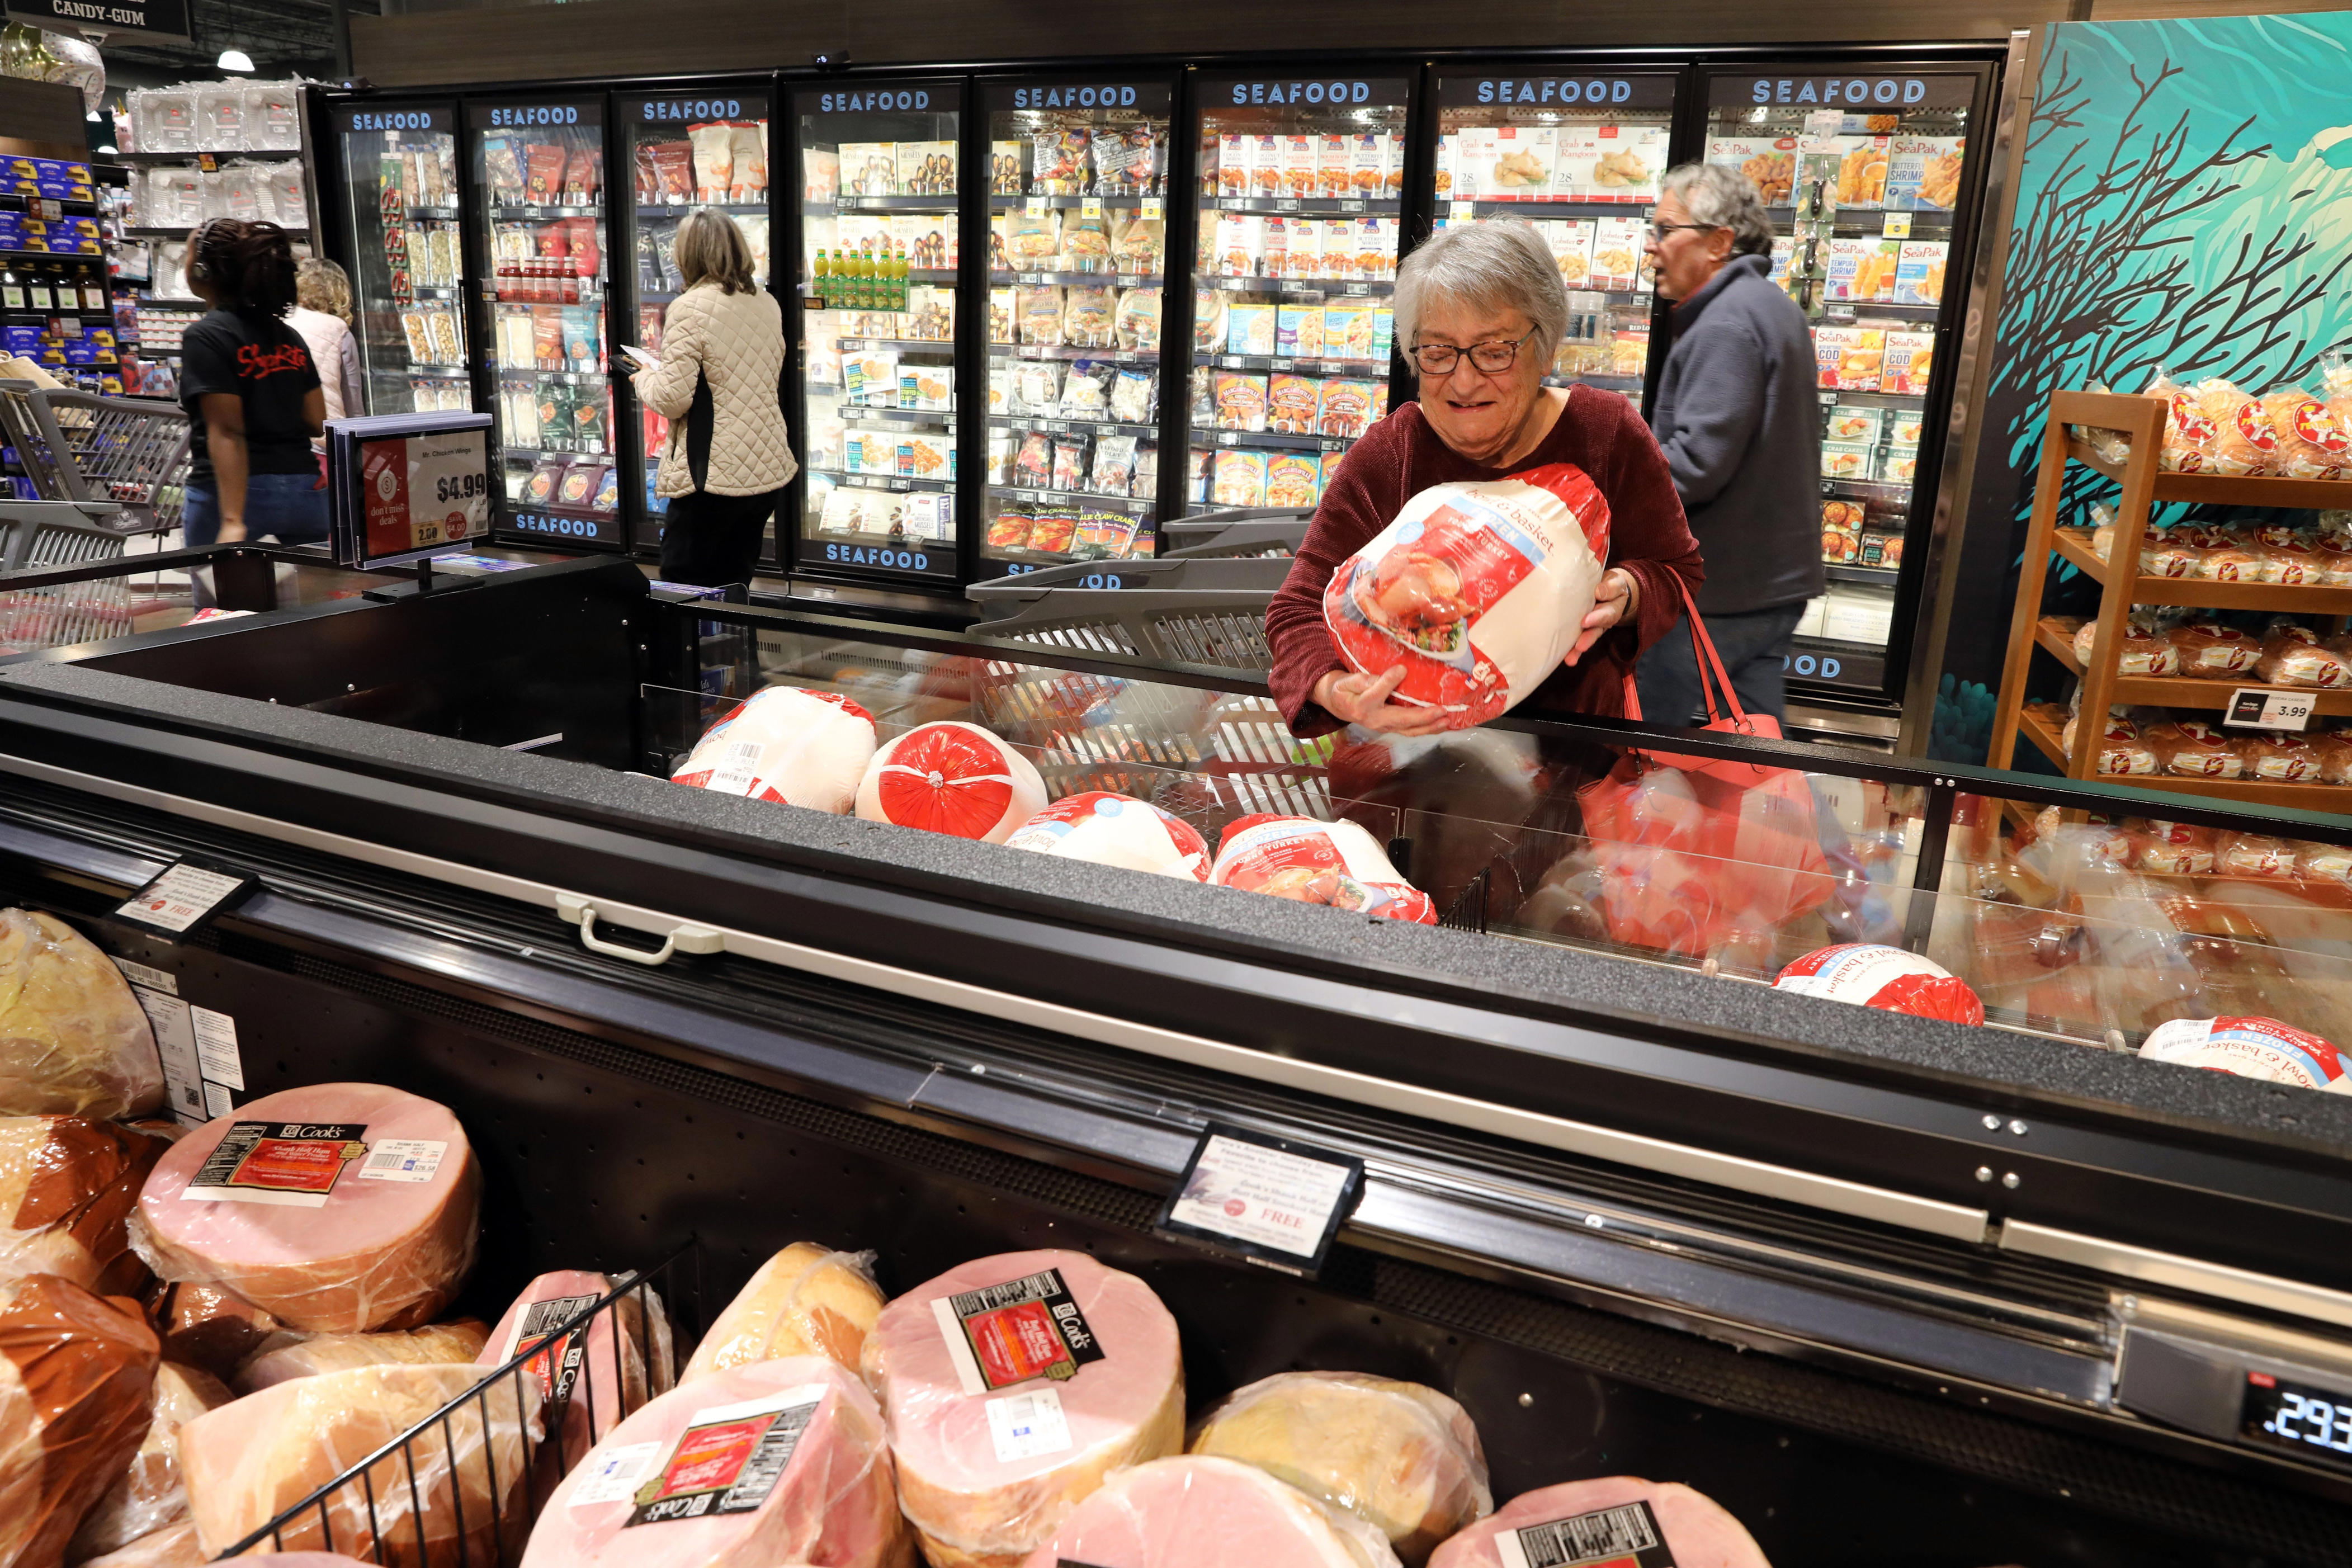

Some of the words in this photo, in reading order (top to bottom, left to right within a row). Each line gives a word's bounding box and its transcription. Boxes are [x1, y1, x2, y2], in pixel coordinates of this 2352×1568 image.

[53, 0, 145, 26] CANDY-GUM
[1232, 82, 1369, 104] SEAFOOD
[1477, 81, 1631, 103] SEAFOOD
[1752, 79, 1925, 103] SEAFOOD
[821, 91, 929, 111] SEAFOOD
[1014, 87, 1136, 107] SEAFOOD
[644, 100, 740, 120] SEAFOOD
[353, 112, 431, 130] SEAFOOD
[492, 107, 578, 125] SEAFOOD
[1460, 140, 1479, 149] Crab
[1560, 139, 1579, 149] Crab
[1712, 144, 1752, 155] SeaPak
[1895, 143, 1938, 154] SeaPak
[1462, 149, 1496, 158] Rangoon
[1561, 148, 1597, 158] Rangoon
[1460, 173, 1473, 183] 28
[1558, 173, 1572, 183] 28
[1890, 171, 1924, 181] SHRIMP
[1600, 231, 1624, 239] Lobster
[1600, 238, 1626, 246] Rangoon
[1832, 244, 1866, 254] SeaPak
[1902, 247, 1942, 258] SeaPak
[1830, 267, 1855, 275] SHRIMP
[1818, 333, 1852, 343] SeaPak
[1888, 337, 1923, 347] SeaPak
[1819, 350, 1839, 360] COD
[1889, 355, 1910, 364] COD
[432, 449, 454, 457] Chicken
[437, 473, 486, 503] $4.99
[371, 506, 388, 516] don't
[389, 505, 404, 513] miss
[380, 517, 397, 526] deals
[516, 514, 597, 537] SEAFOOD
[1114, 516, 1136, 526] CRABS
[447, 523, 465, 532] $4.00
[419, 527, 437, 541] 2.00
[1476, 532, 1510, 560] TURKEY
[826, 544, 927, 570] SEAFOOD
[2279, 706, 2306, 717] 3.99
[1239, 829, 1293, 851] FROZEN
[1232, 849, 1263, 865] YOUNG
[1265, 838, 1306, 851] TURKEY
[1268, 848, 1292, 857] INCLUDED
[169, 905, 195, 916] FREE
[1876, 950, 1916, 961] bowl
[1827, 958, 1863, 994] basket
[2241, 1032, 2304, 1059] FROZEN
[2265, 1052, 2280, 1061] &
[300, 1126, 341, 1138] Cook's
[1261, 1208, 1305, 1229] FREE
[1061, 1317, 1090, 1349] Cook's
[644, 1497, 693, 1521] Cook's
